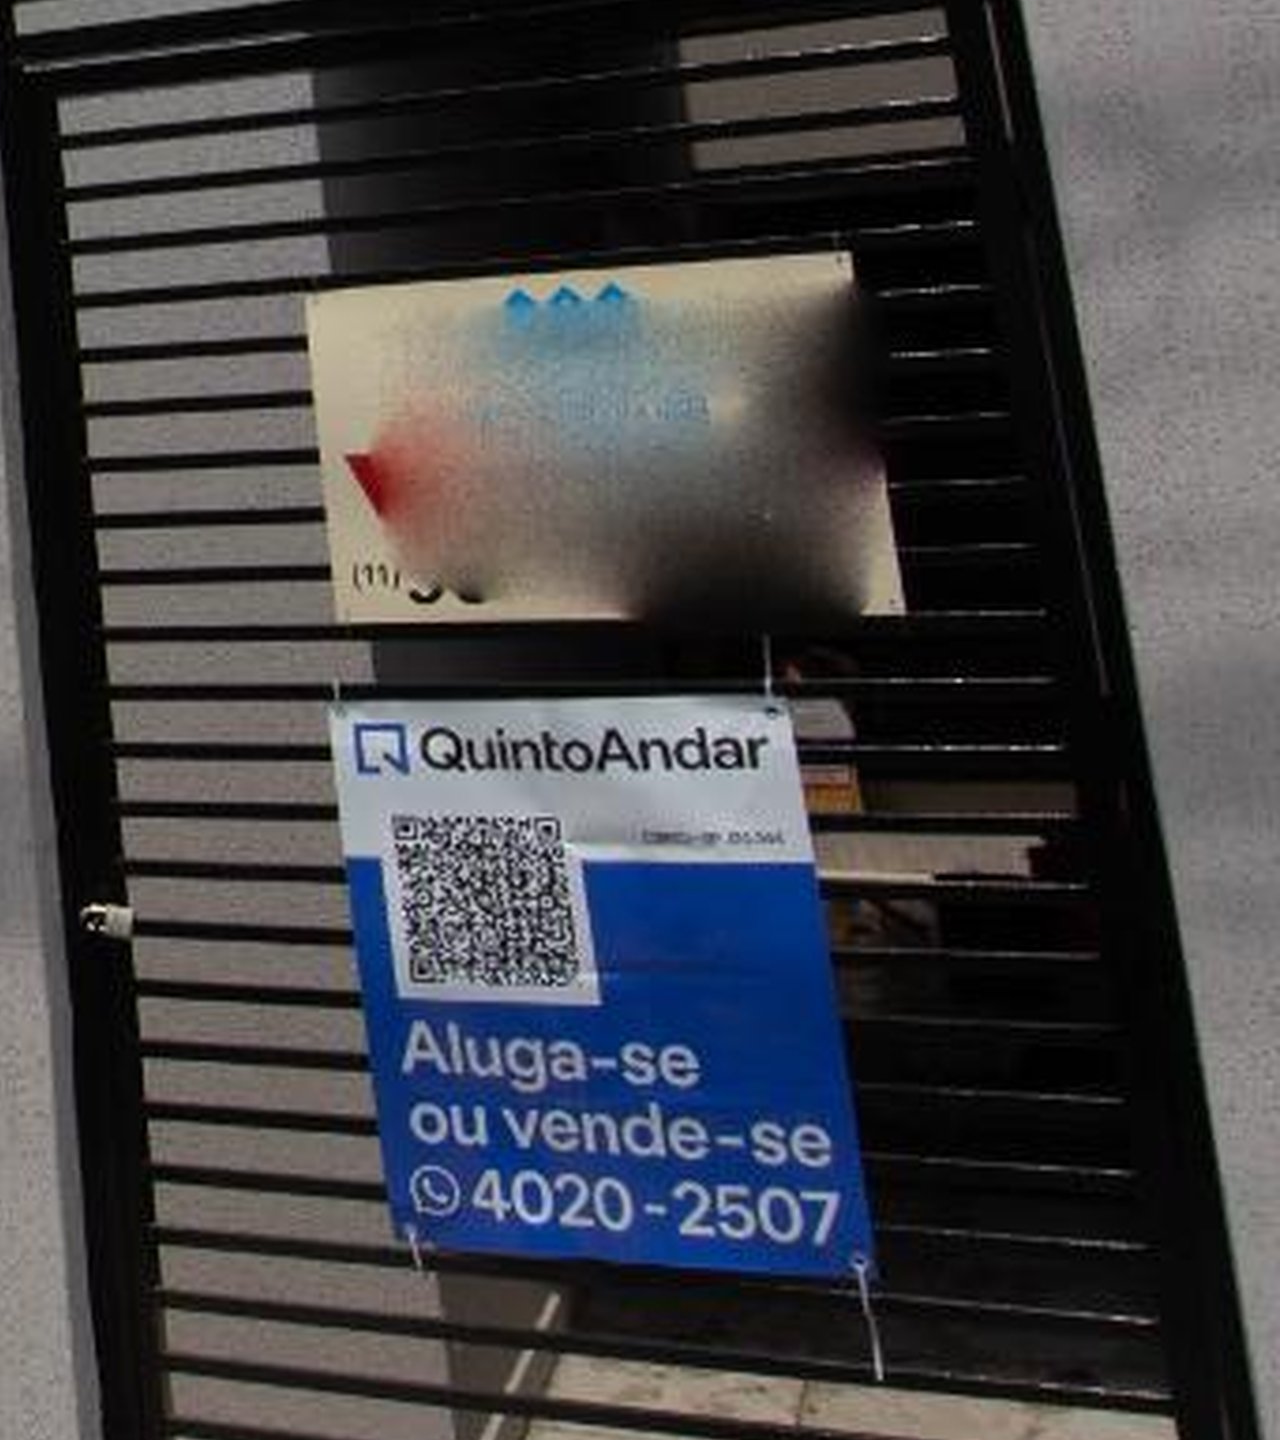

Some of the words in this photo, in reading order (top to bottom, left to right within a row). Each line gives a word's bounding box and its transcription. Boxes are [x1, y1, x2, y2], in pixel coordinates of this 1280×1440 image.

[420, 726, 770, 774] QuintoAndar
[402, 1020, 700, 1092] Aluga-se
[409, 1101, 488, 1146] ou
[502, 1102, 833, 1168] vende-se
[472, 1170, 841, 1246] 4020-2507
